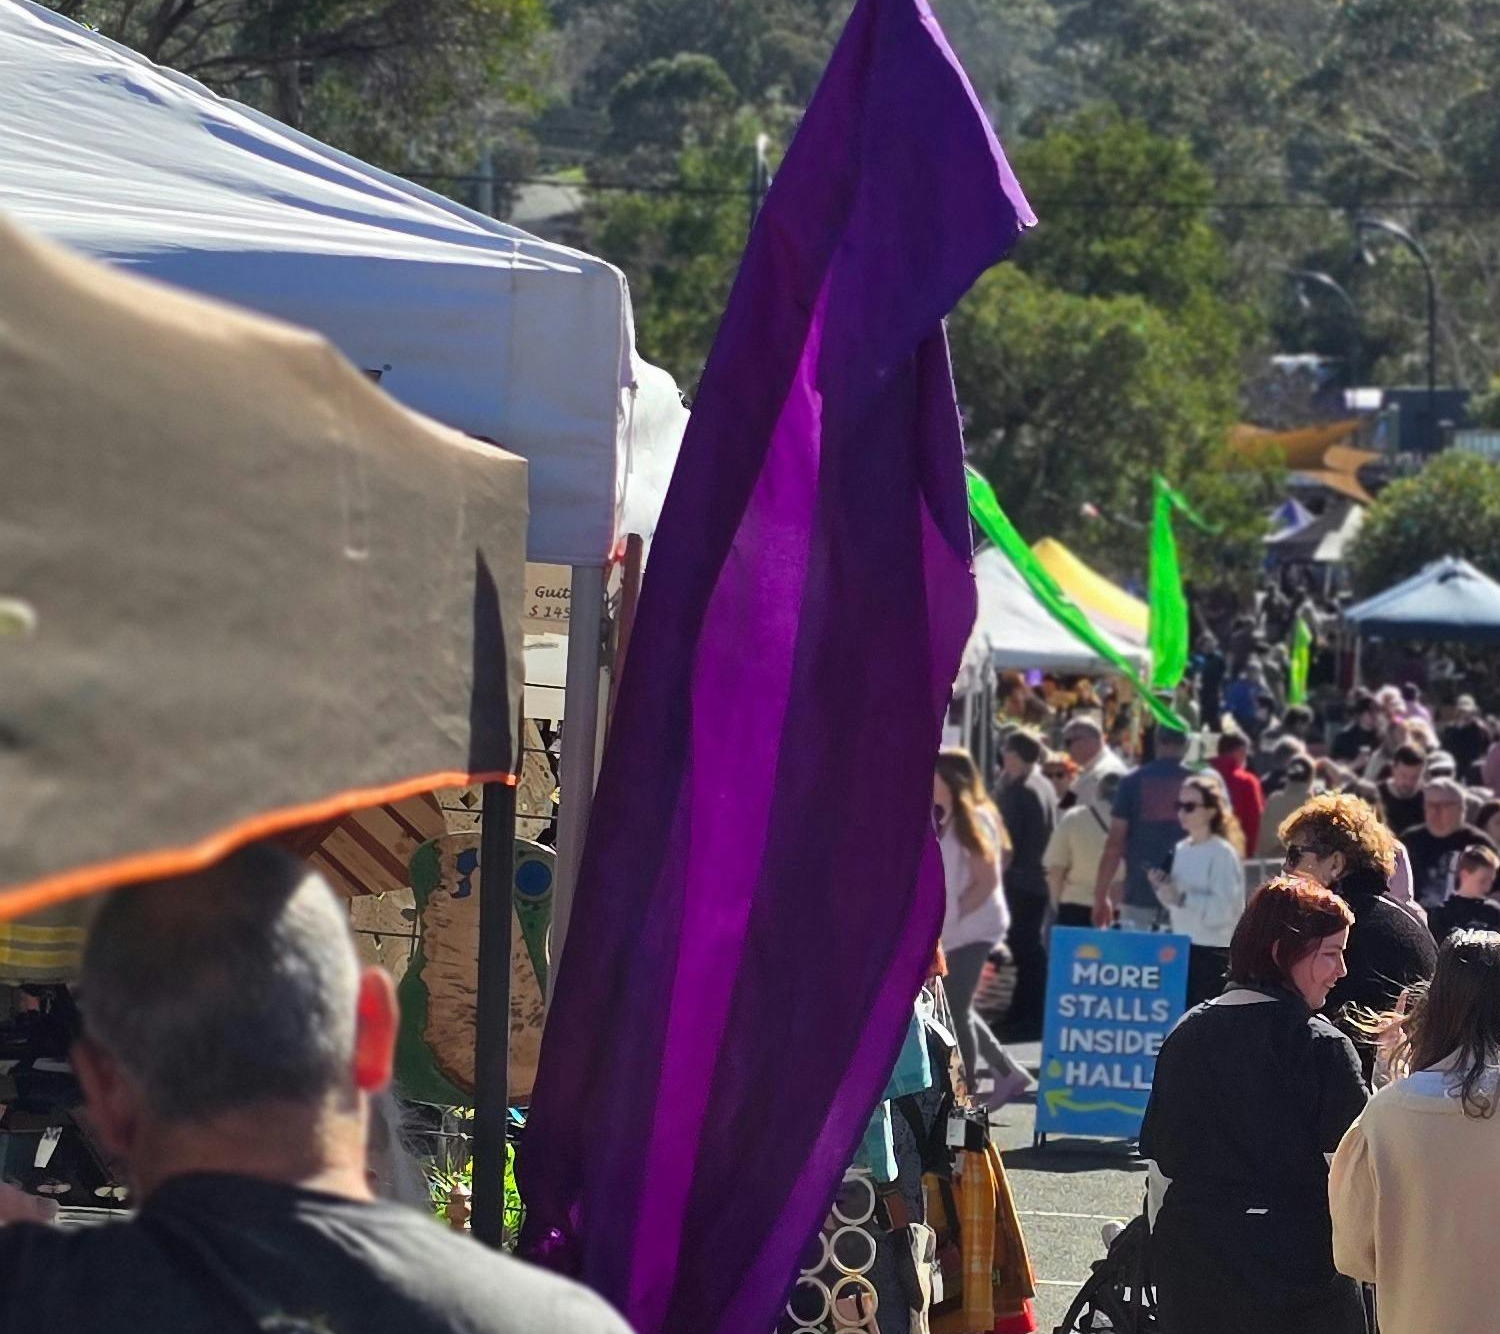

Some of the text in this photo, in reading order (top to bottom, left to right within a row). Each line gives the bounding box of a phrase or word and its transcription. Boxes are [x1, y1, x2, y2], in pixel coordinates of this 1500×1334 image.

[1072, 962, 1160, 989] MORE
[1058, 993, 1169, 1022] STALLS
[1060, 1027, 1163, 1056] INSIDE
[1065, 1060, 1152, 1089] HALL
